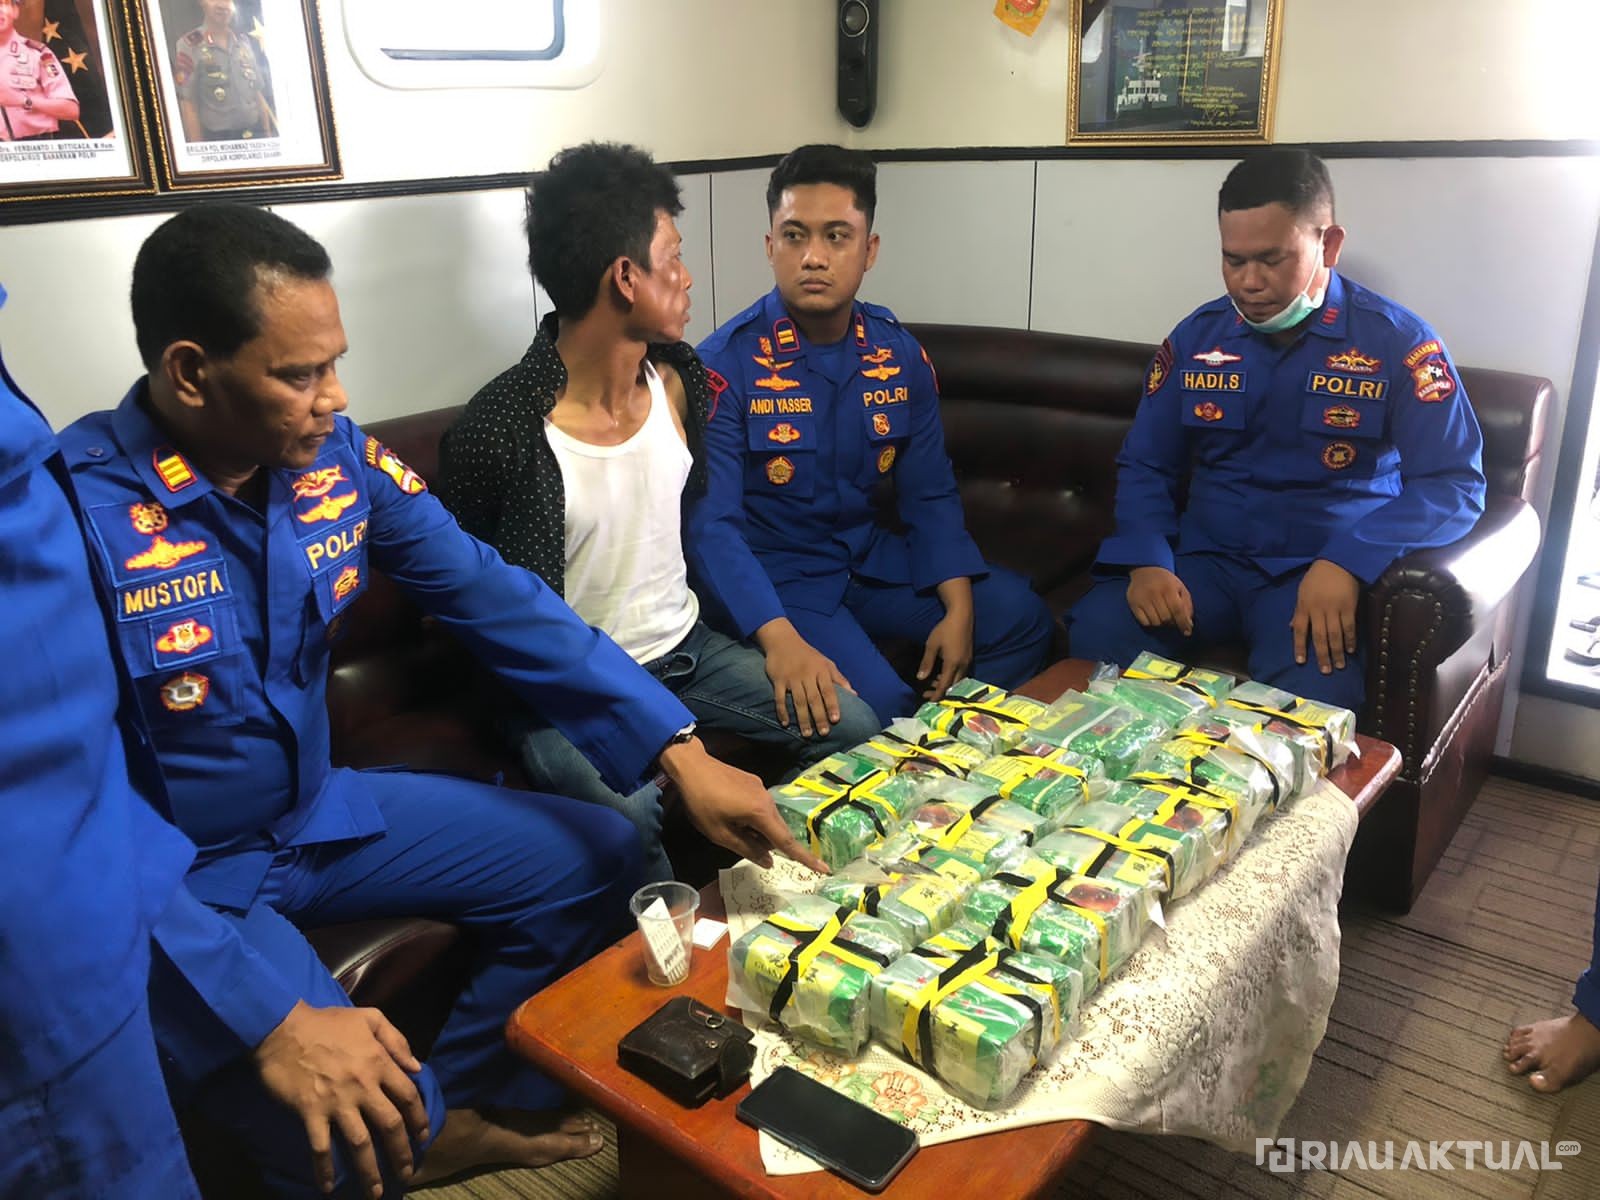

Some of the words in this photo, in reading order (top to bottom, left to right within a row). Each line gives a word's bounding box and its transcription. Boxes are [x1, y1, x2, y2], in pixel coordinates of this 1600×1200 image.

[863, 386, 908, 408] POLRI
[1312, 375, 1383, 398] POLRI
[749, 398, 775, 415] ANDI
[776, 397, 813, 414] YASSER
[124, 569, 224, 614] MUSTOFA
